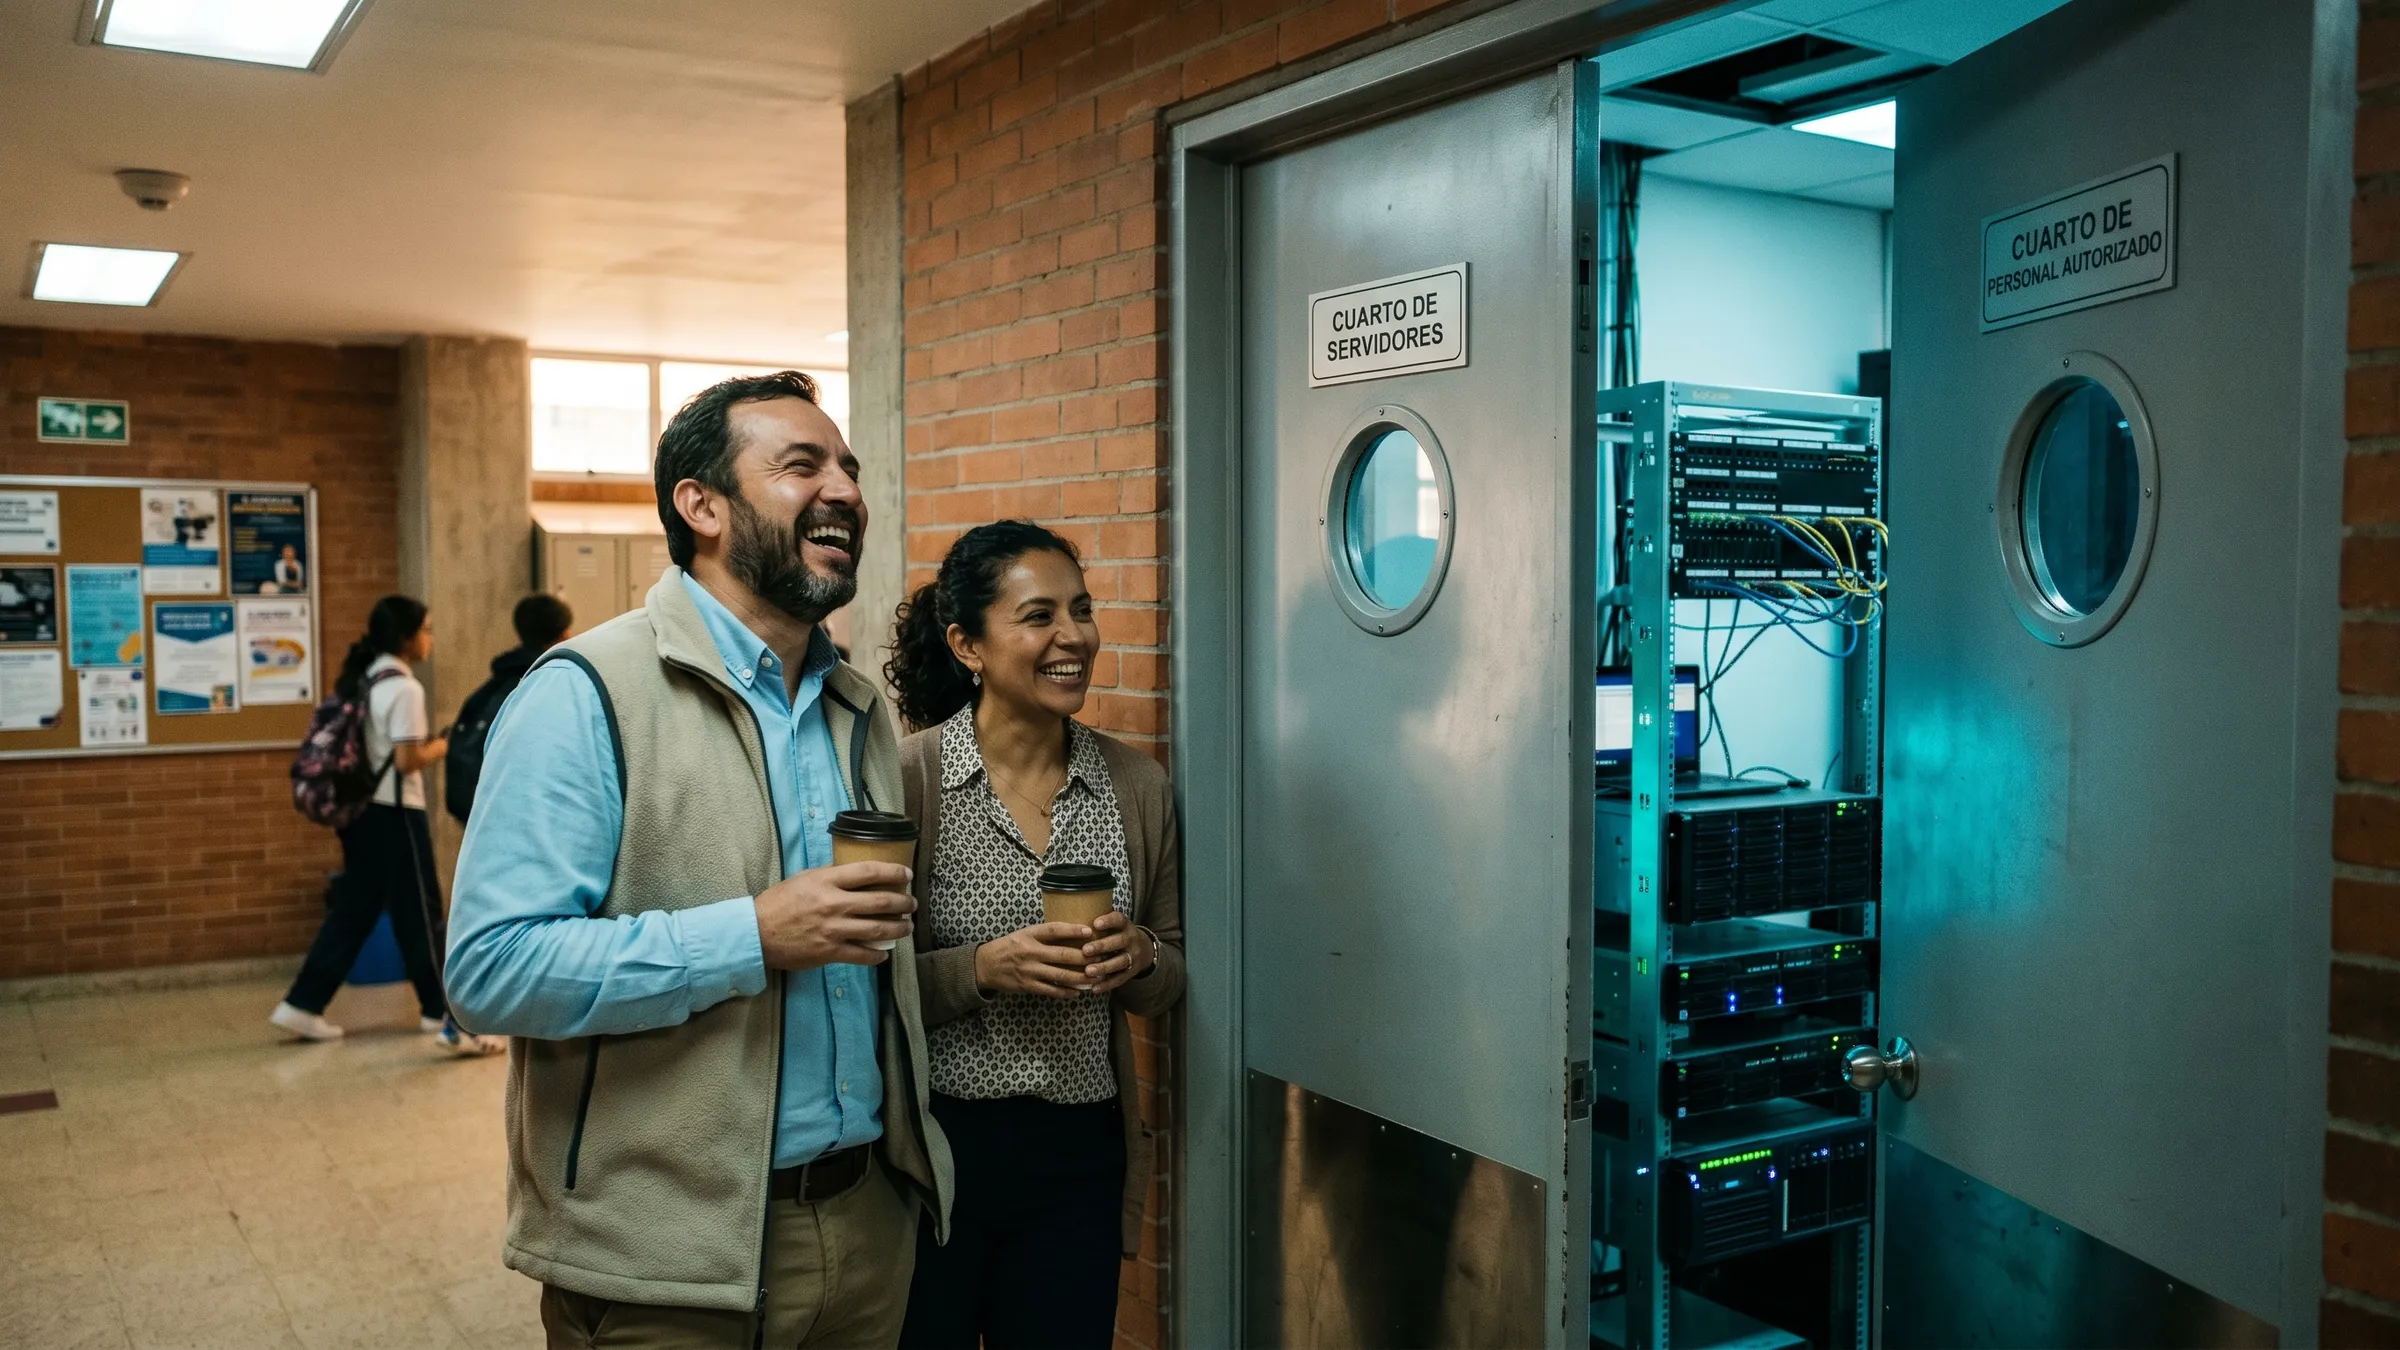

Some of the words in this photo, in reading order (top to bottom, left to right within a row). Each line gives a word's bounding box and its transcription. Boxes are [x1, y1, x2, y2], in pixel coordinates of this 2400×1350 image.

[2012, 211, 2096, 261] CUARTO
[2103, 198, 2133, 235] DE
[1988, 262, 2060, 298] PERSONAL
[2062, 230, 2162, 278] AUTORIZADO
[1332, 298, 1407, 332] CUARTO
[1413, 292, 1438, 318] DE
[1327, 322, 1443, 362] SERVIDORES
